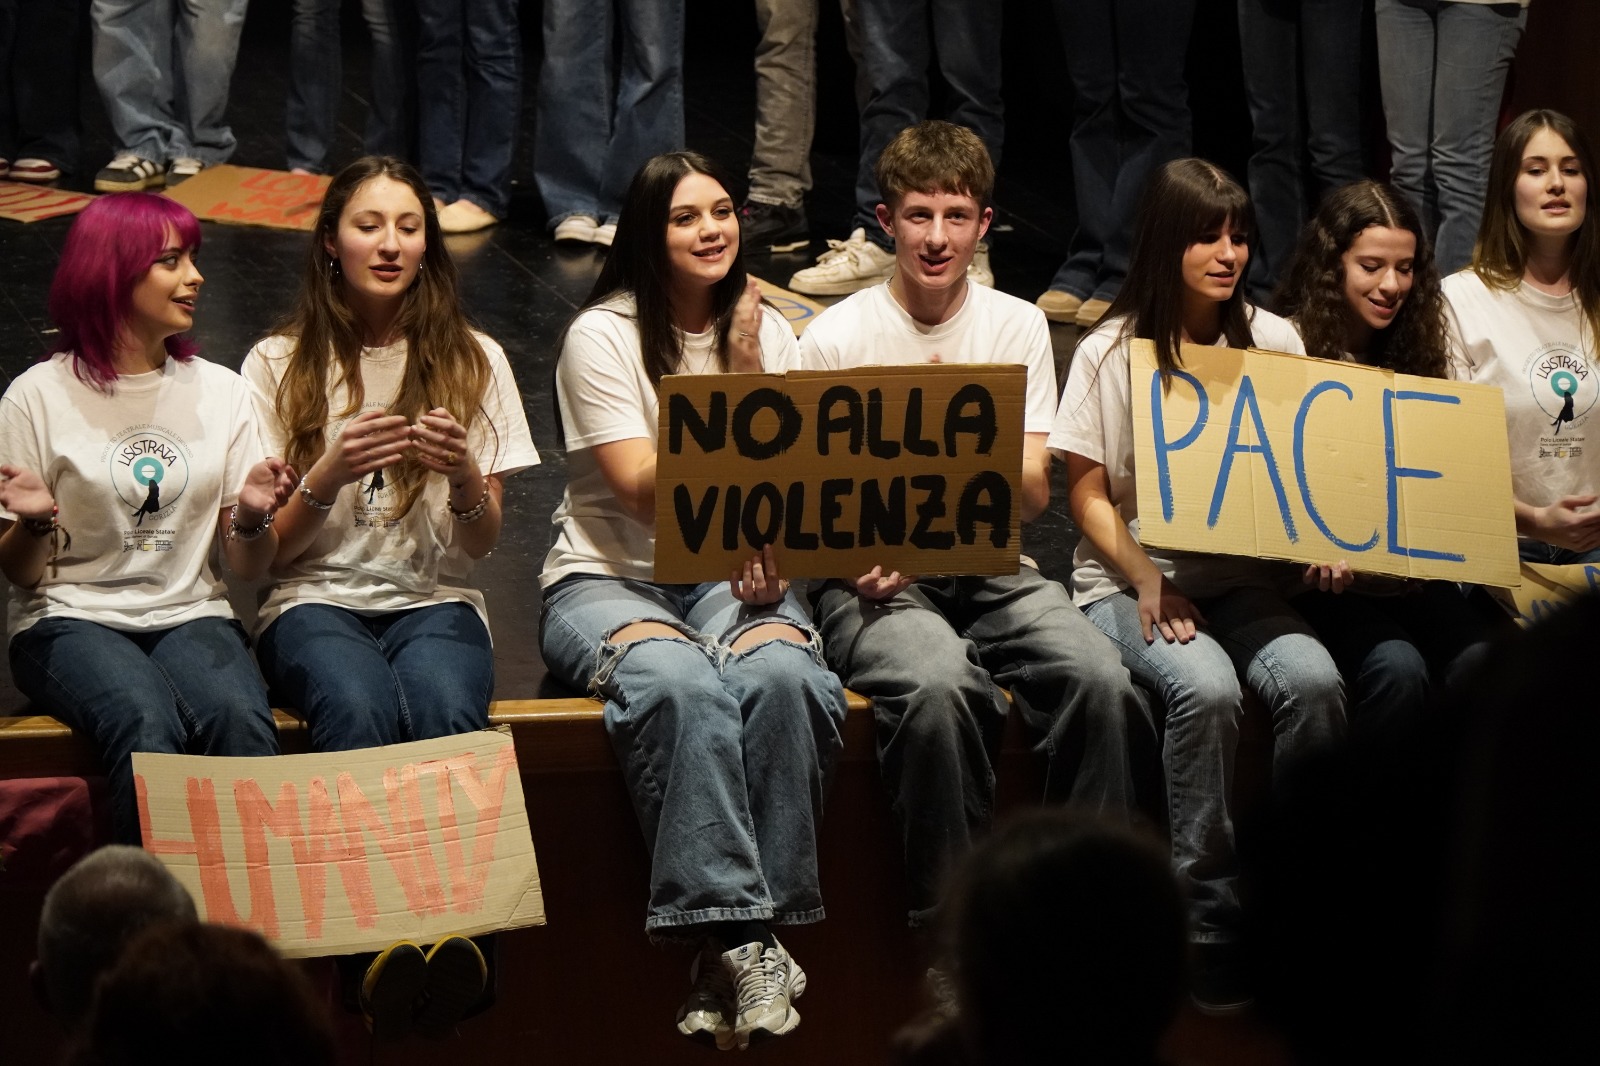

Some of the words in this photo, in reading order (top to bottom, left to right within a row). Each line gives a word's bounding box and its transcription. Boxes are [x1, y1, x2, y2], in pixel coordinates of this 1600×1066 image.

[240, 171, 327, 194] LOV
[1536, 355, 1589, 381] LISISTRATA
[116, 424, 146, 439] TEATRALE
[669, 387, 803, 460] NO
[817, 384, 998, 460] ALLA
[118, 440, 177, 467] LISISTRATA
[1151, 368, 1466, 563] PACE
[149, 505, 177, 521] GORIZIA
[673, 471, 1012, 554] VIOLENZA
[133, 744, 518, 940] HUMANITY
